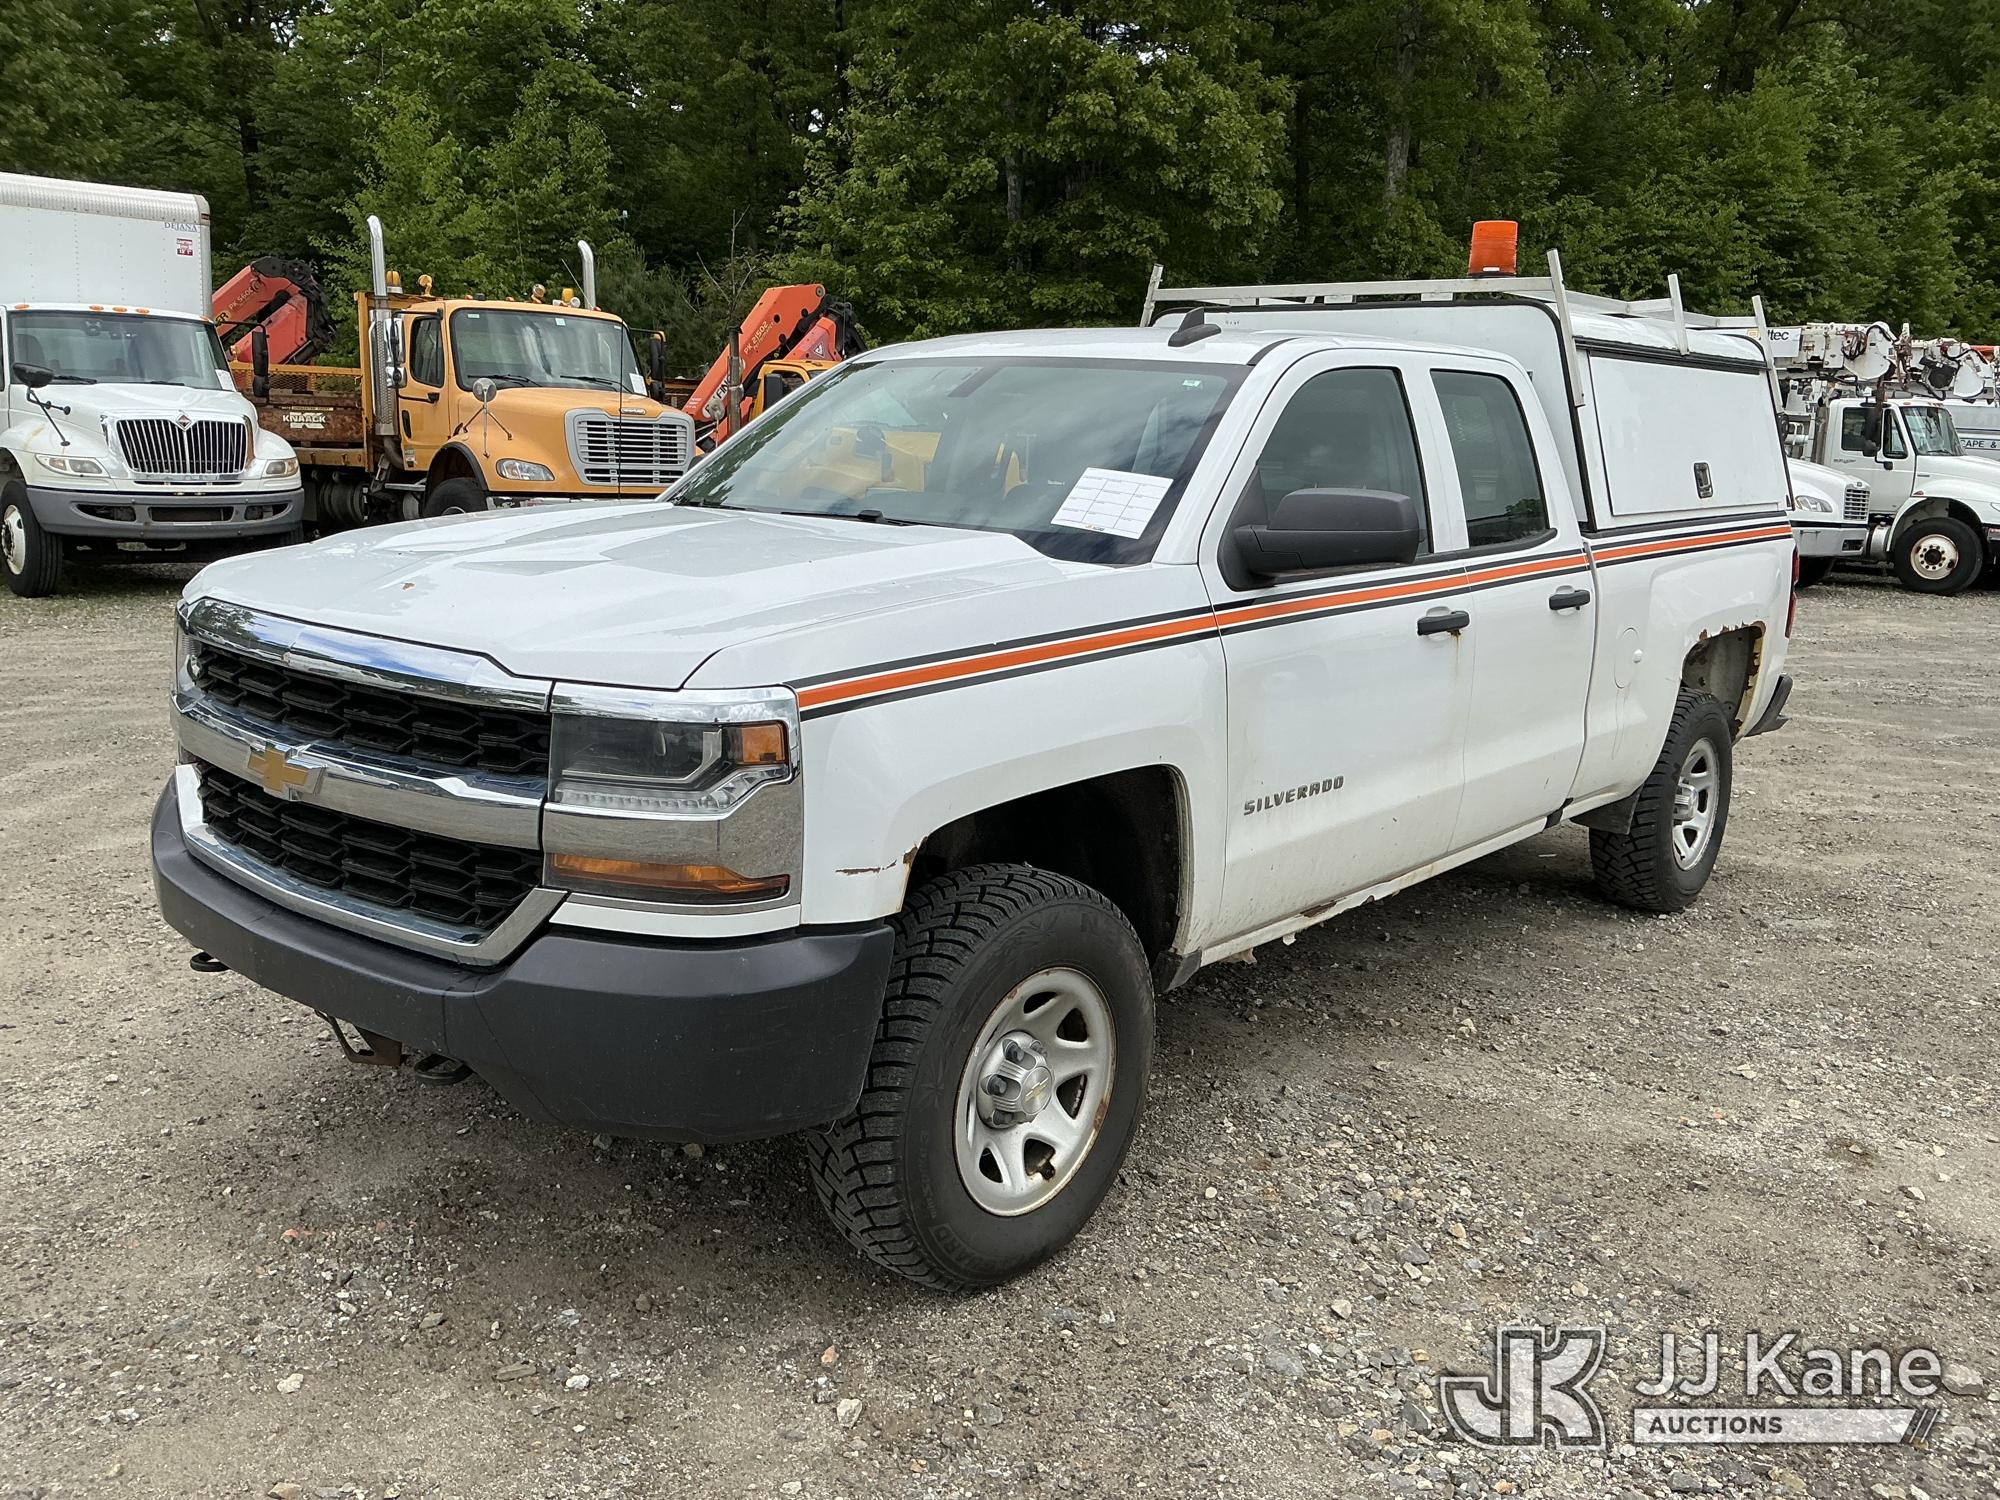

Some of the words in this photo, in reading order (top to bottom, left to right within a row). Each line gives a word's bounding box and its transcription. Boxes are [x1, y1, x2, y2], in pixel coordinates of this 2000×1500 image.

[164, 222, 198, 233] DEJANA
[282, 414, 326, 423] KNAACK
[1990, 440, 1997, 449] &
[1243, 775, 1344, 816] SILVERADO
